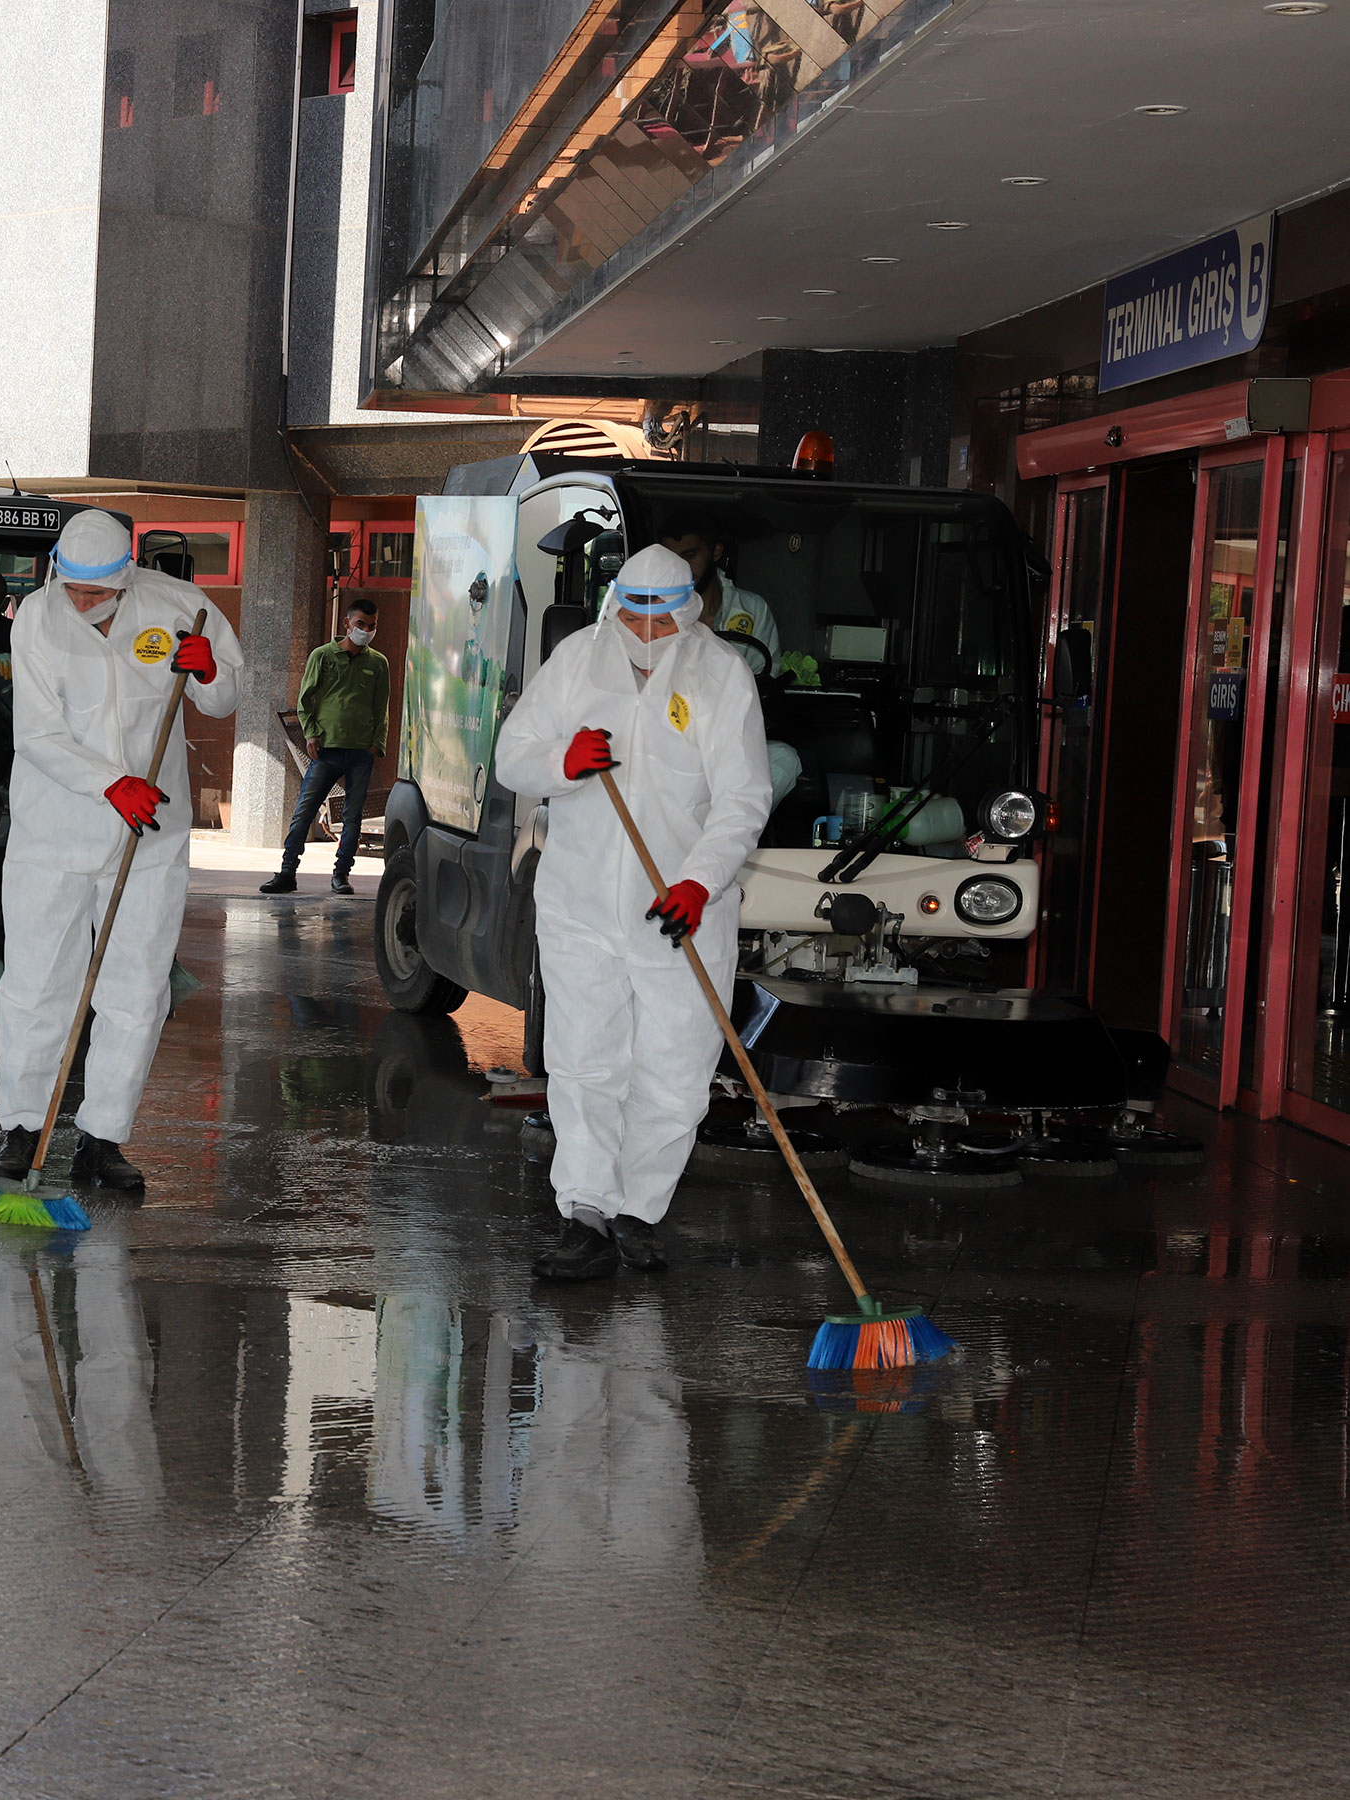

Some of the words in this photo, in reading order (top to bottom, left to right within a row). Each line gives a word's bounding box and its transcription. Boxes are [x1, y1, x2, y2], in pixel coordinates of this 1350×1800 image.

[1107, 277, 1183, 364] TERMİNAL
[1187, 249, 1237, 346] GİRİŞ
[1246, 242, 1265, 319] B
[22, 511, 40, 526] BB
[42, 512, 56, 527] 19
[1210, 677, 1237, 717] GİRİŞ
